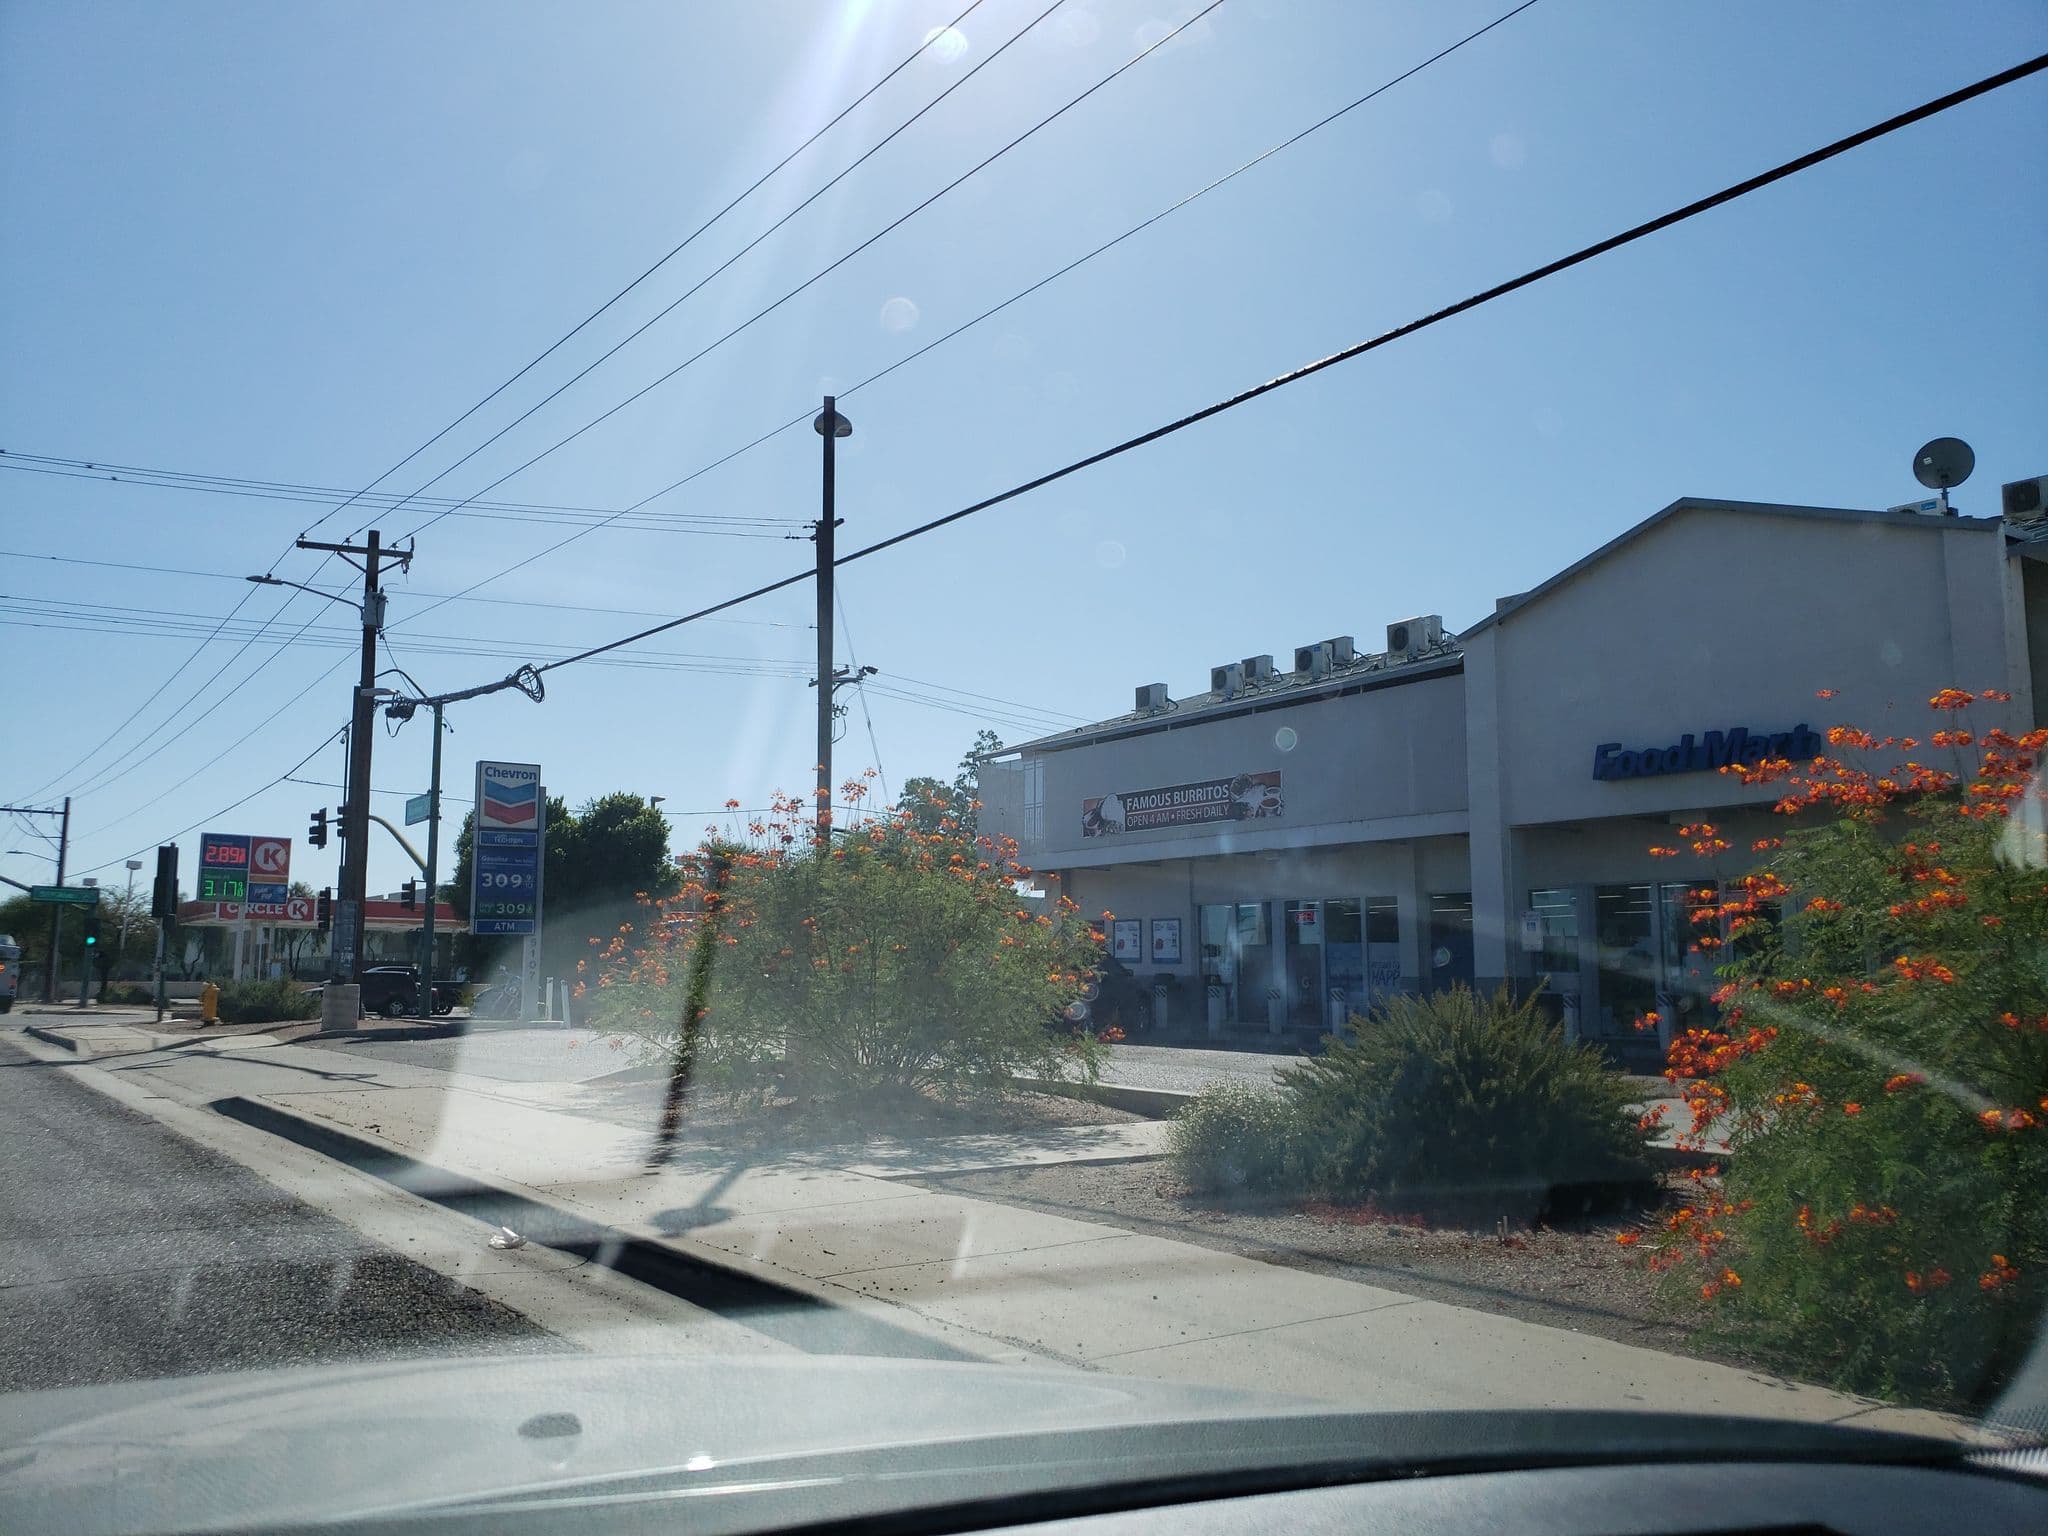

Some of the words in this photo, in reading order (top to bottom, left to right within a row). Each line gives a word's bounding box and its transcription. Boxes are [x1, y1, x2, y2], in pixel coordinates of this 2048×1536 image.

[1593, 733, 1695, 781] Food
[1699, 723, 1822, 770] Mart
[484, 766, 537, 780] Chevron
[1126, 793, 1172, 811] FAMOUS
[1173, 784, 1229, 804] BURRITOS
[1126, 813, 1149, 827] OPEN
[1150, 812, 1156, 825] 4
[1156, 811, 1170, 824] AM
[1176, 806, 1202, 822] FRESH
[1203, 803, 1229, 818] DAILY
[481, 872, 522, 888] 309
[226, 902, 284, 914] CRCLE
[496, 903, 525, 914] 309
[494, 922, 515, 931] ATM
